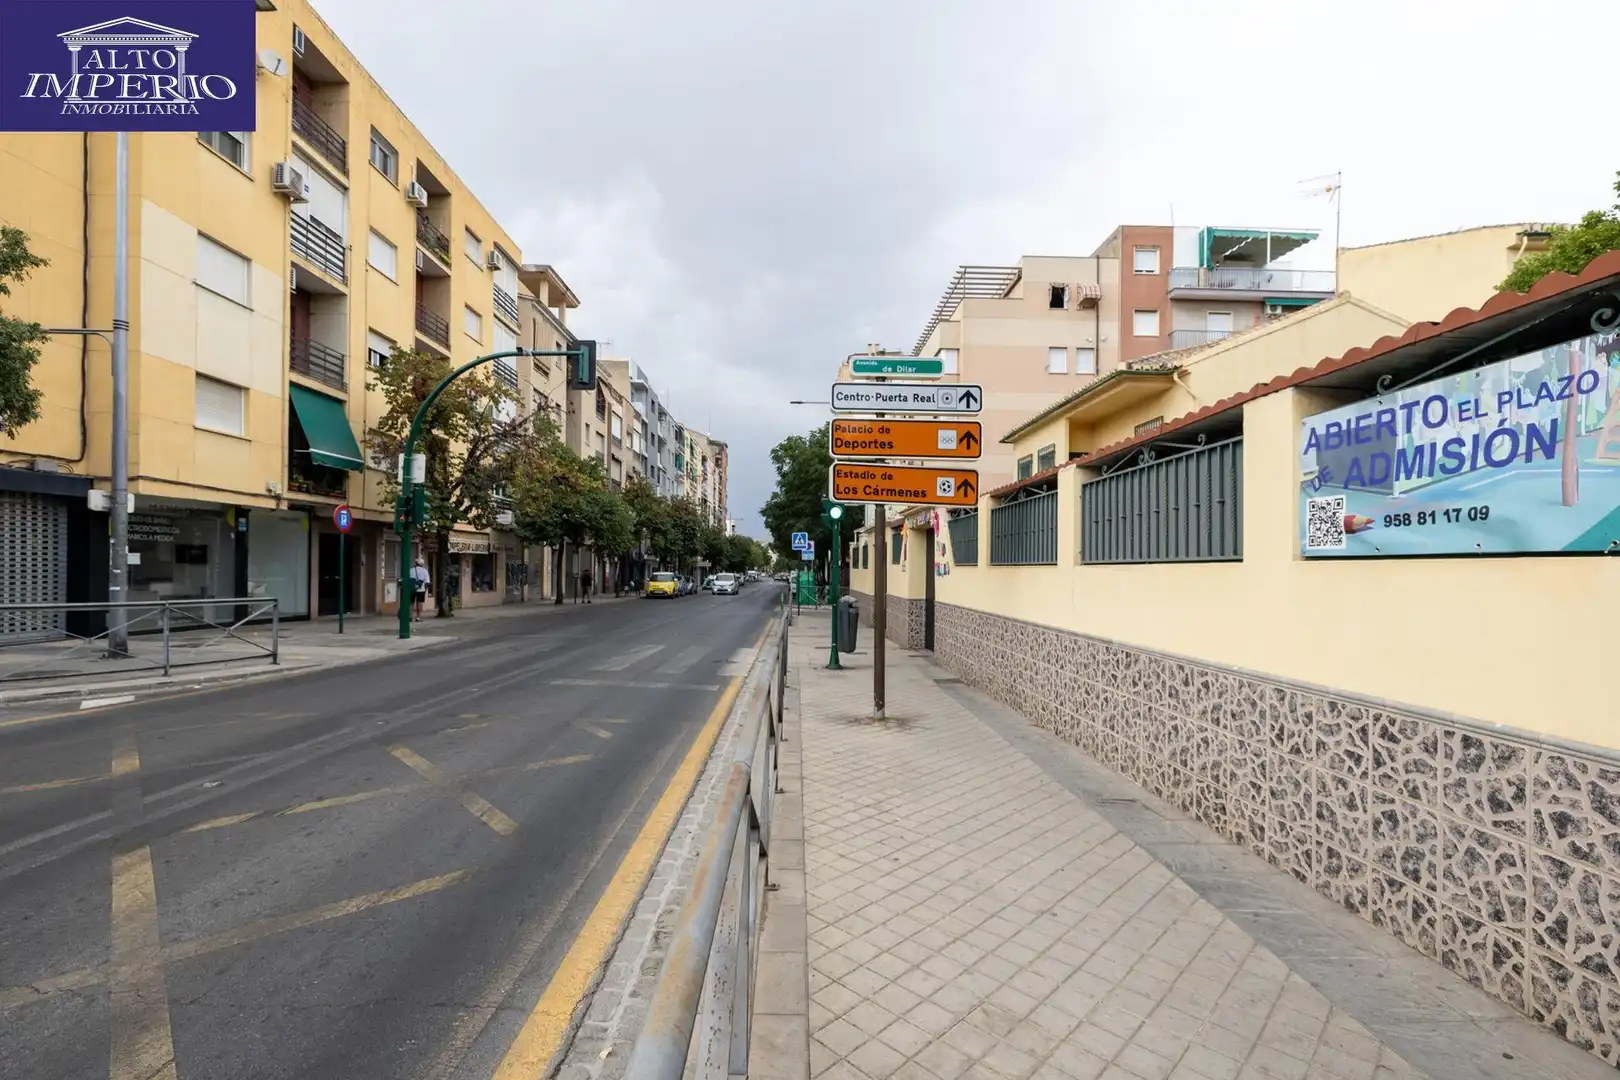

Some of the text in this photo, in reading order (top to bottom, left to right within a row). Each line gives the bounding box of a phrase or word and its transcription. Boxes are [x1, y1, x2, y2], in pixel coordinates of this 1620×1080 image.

[882, 365, 893, 373] de
[913, 393, 936, 403] Real
[1303, 369, 1600, 455] ABIERTO EL PLAZO
[834, 424, 891, 434] Palacio de
[834, 437, 894, 451] Deportes
[1310, 417, 1559, 493] DE ADMISIÓN
[836, 469, 893, 480] Estadio de
[835, 482, 927, 498] Los Cármenes
[1383, 505, 1490, 528] 958 81 17 09
